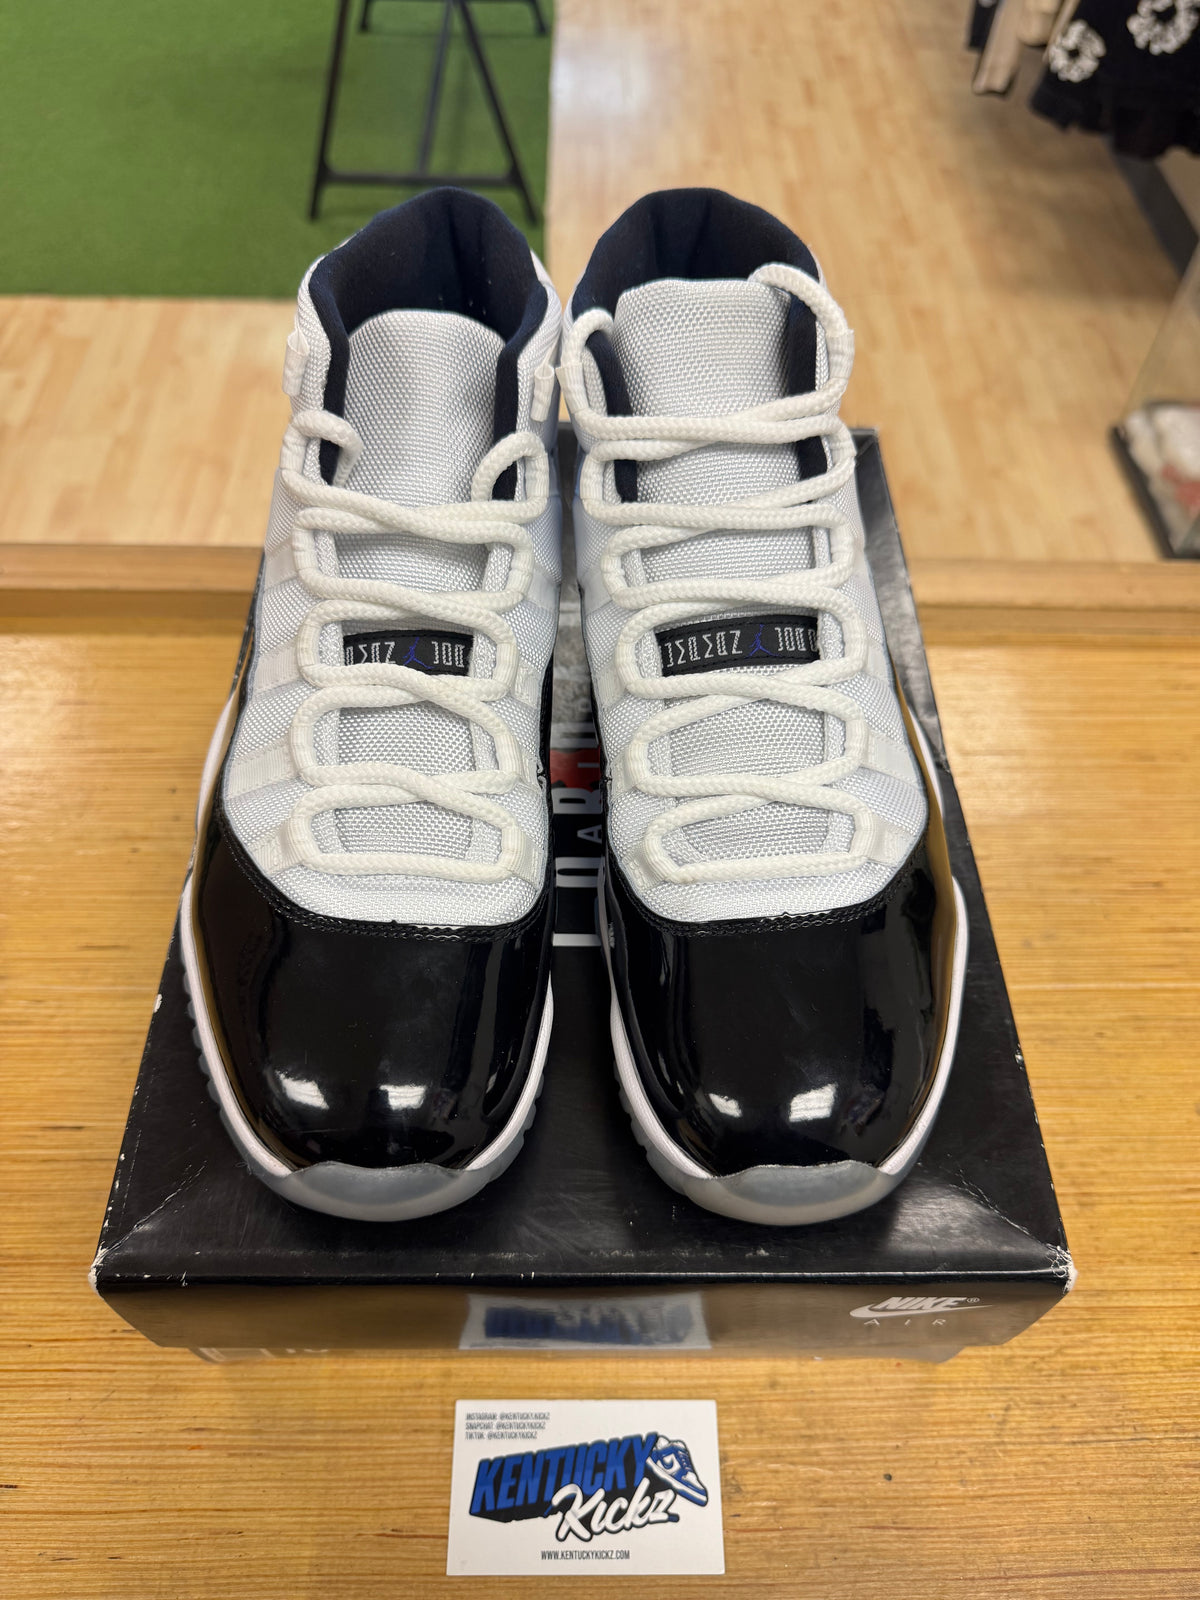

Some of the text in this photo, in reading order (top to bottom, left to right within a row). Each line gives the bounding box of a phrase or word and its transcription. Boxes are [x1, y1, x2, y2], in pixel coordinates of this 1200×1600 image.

[871, 1297, 967, 1310] NIKE
[470, 1432, 658, 1521] KENTUCKY
[541, 1550, 630, 1560] WWW.KENTUCKYKICKZ.COM
